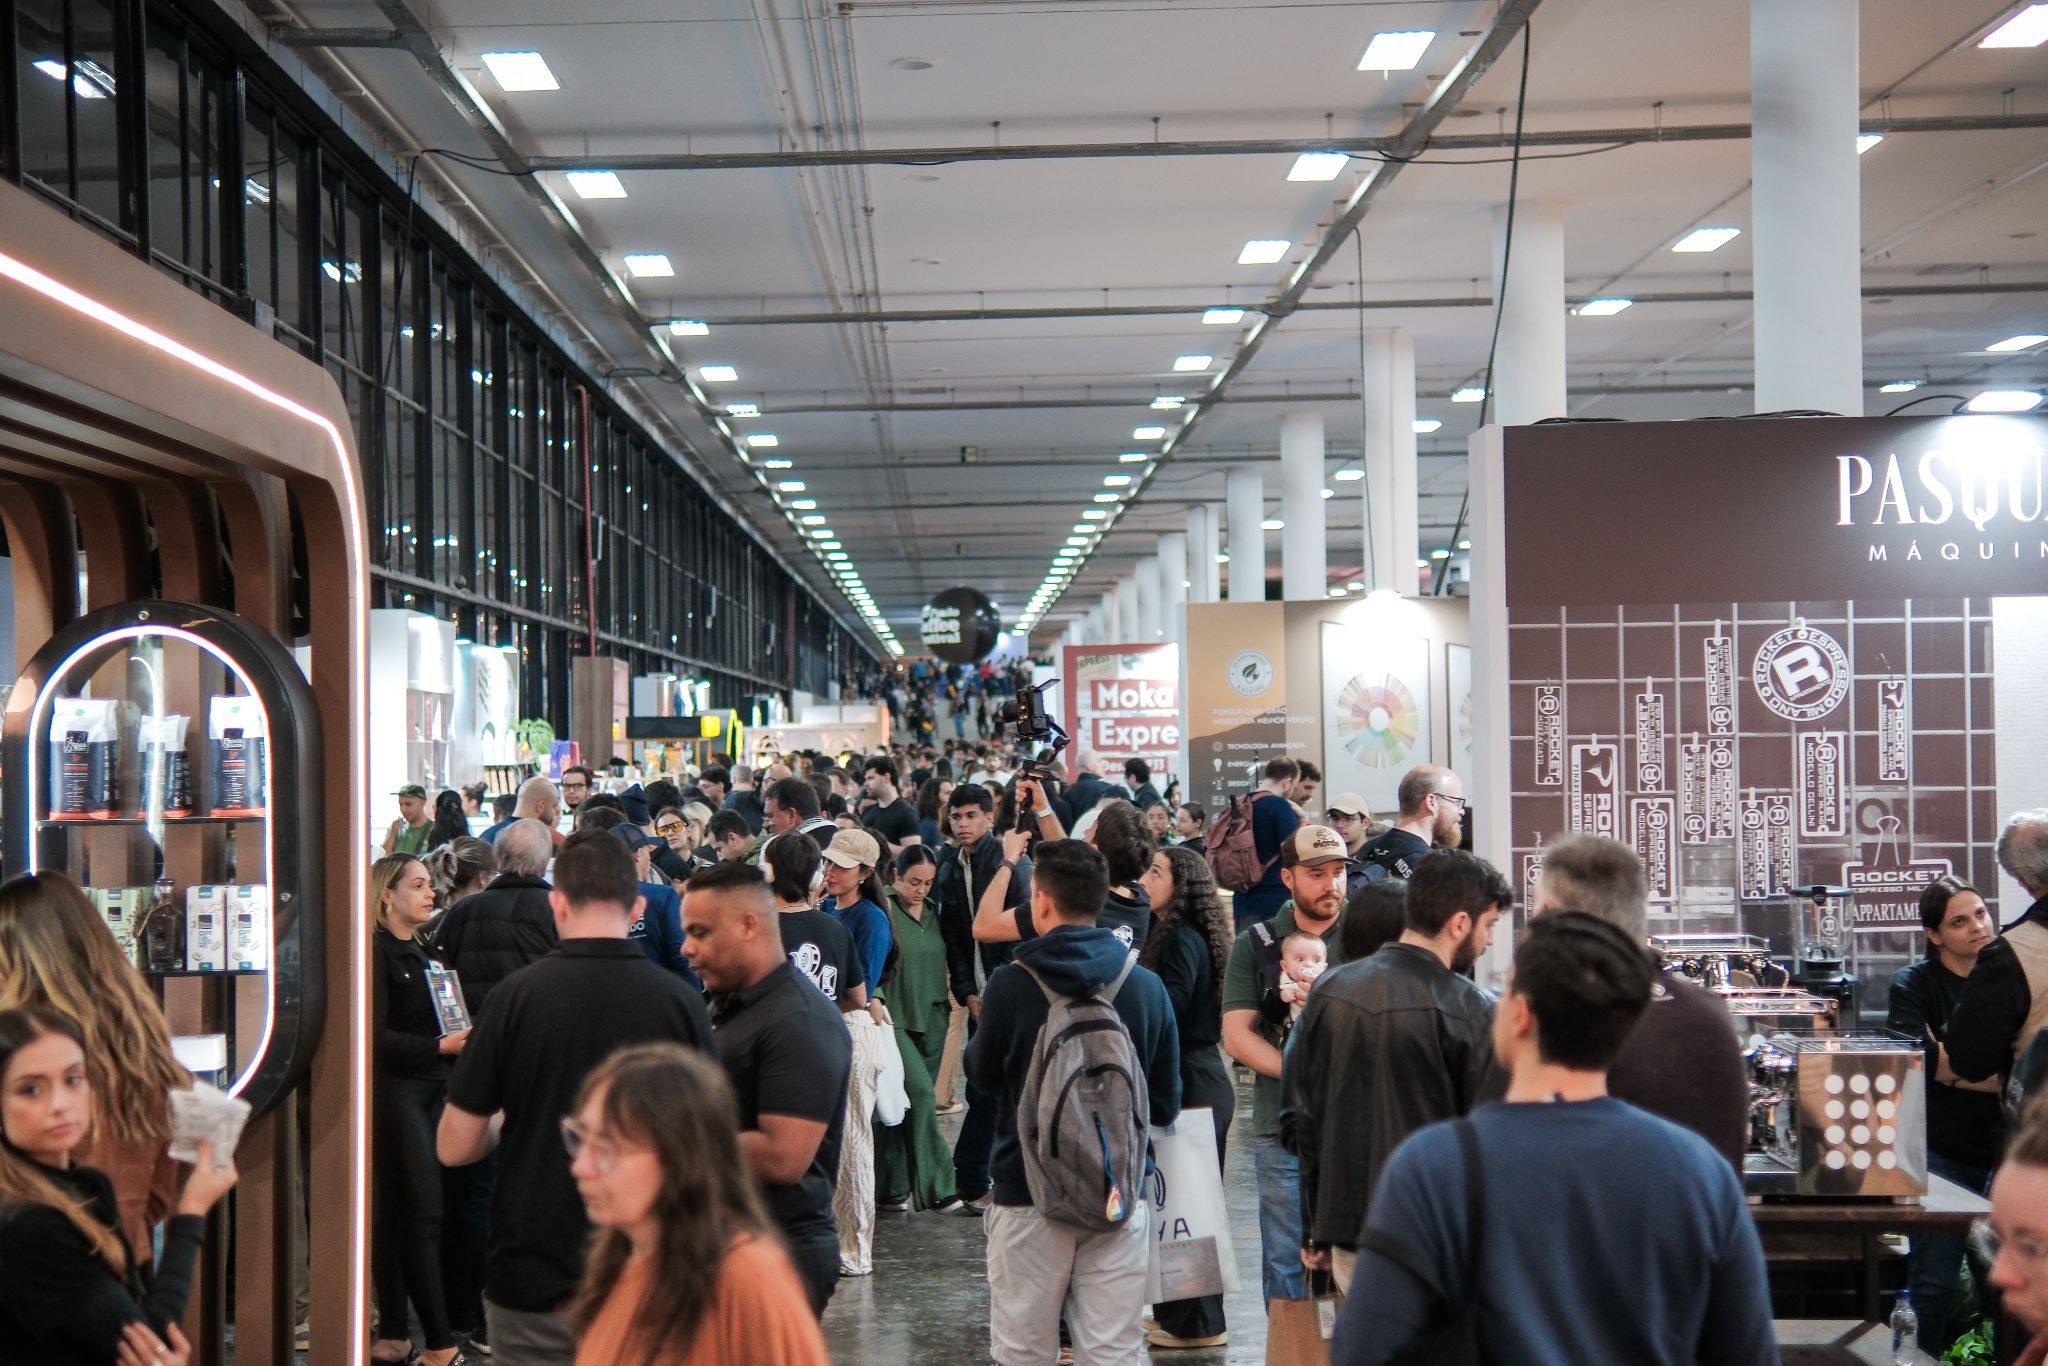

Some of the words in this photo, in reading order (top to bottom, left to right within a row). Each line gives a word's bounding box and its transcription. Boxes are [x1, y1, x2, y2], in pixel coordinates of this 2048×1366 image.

[1835, 448, 2048, 532] PASQU
[1708, 646, 1719, 705] ROCKET
[1756, 631, 1794, 684] ROCKET
[1808, 631, 1846, 699] ESPRESSO
[1098, 681, 1174, 708] Moka
[1769, 696, 1826, 718] MILANO
[1099, 719, 1179, 751] Expre
[1549, 715, 1561, 778] ROCKET
[1640, 703, 1648, 763] ROCKET
[1895, 709, 1904, 770] ROCKET
[1684, 752, 1693, 813] ROCKET
[1807, 742, 1815, 787] MODELLO
[1825, 764, 1835, 825] ROCKET
[1722, 769, 1732, 829] ROCKET
[1807, 792, 1815, 827] CELLINI
[1638, 808, 1646, 853] MODELLO
[1656, 829, 1666, 890] ROCKET
[1755, 829, 1765, 889] ROCKET
[1781, 826, 1791, 886] ROCKET
[1851, 870, 1944, 883] ROCKET
[1853, 902, 1922, 922] APPARTAME
